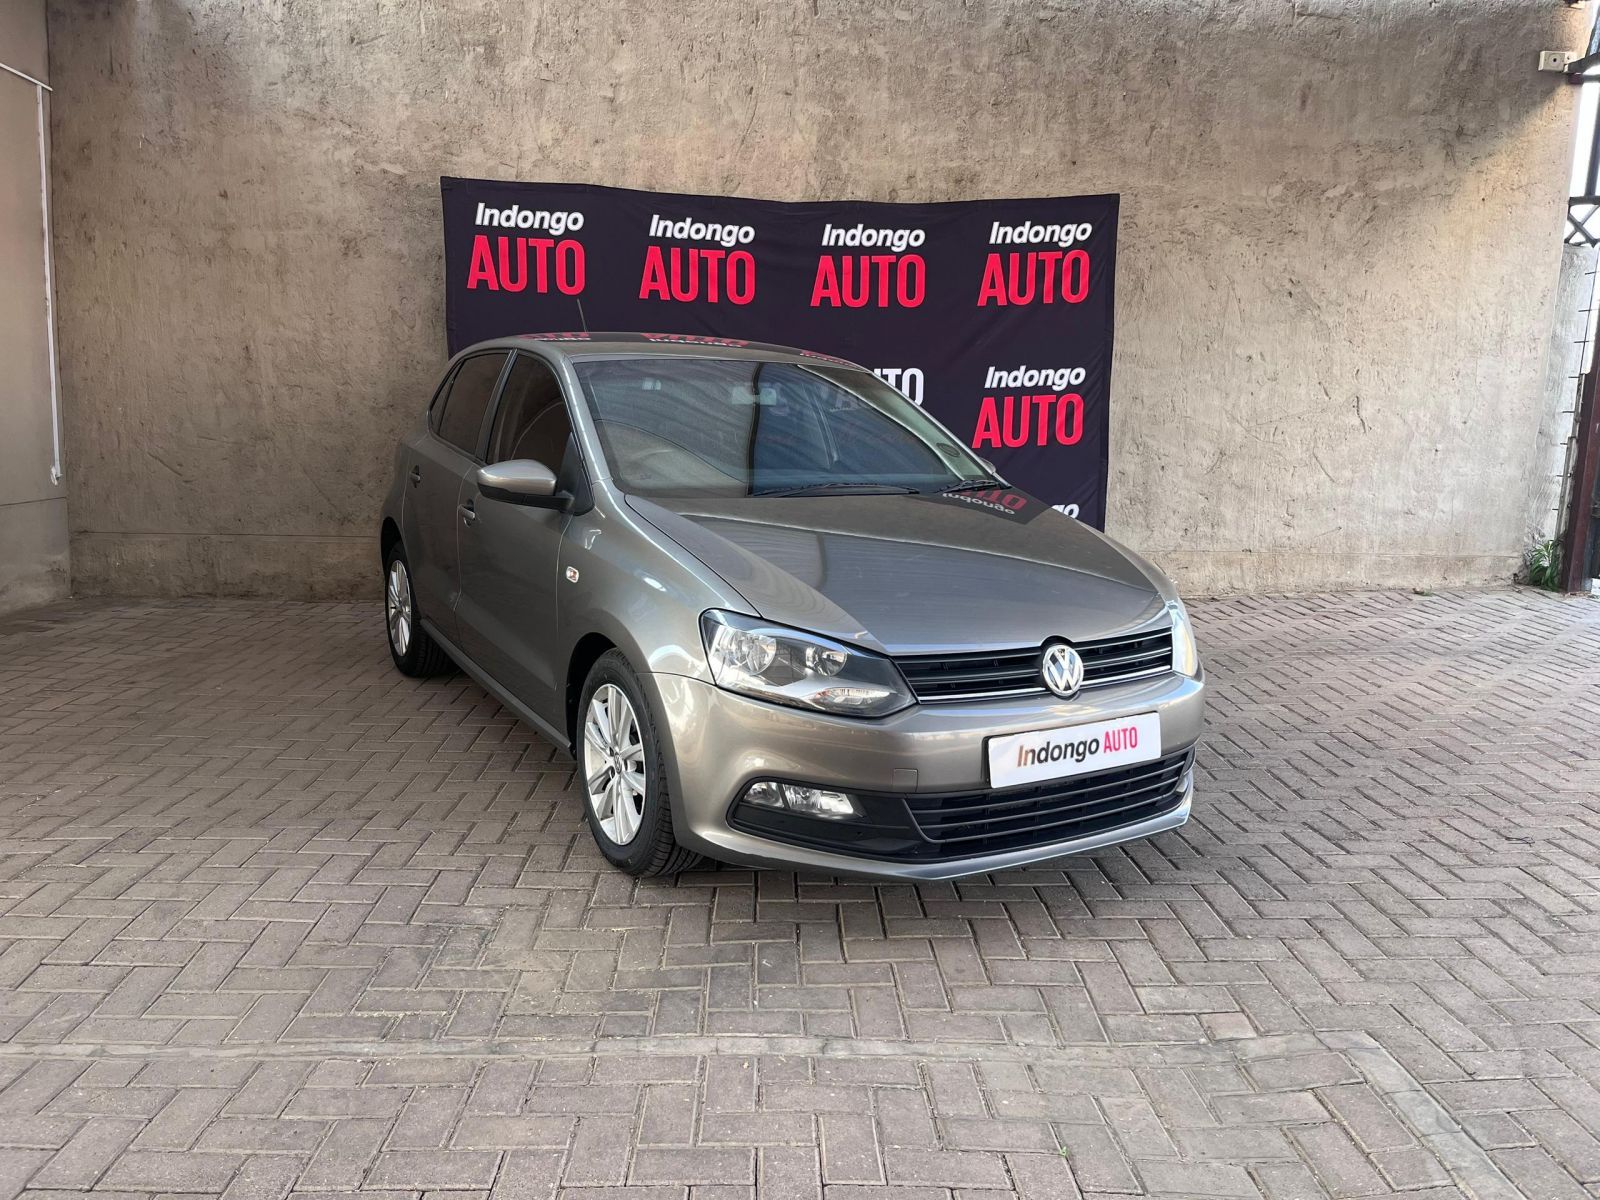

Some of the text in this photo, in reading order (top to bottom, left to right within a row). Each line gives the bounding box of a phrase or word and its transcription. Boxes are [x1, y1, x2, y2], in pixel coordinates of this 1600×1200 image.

[475, 203, 584, 236] Indongo
[649, 214, 756, 247] Indongo
[822, 223, 925, 252] Indongo
[989, 220, 1092, 248] Indongo
[467, 234, 586, 296] AUTO
[639, 244, 757, 306] AUTO
[810, 253, 926, 308] AUTO
[977, 248, 1090, 307] AUTO
[985, 364, 1087, 392] Indongo
[973, 393, 1085, 448] AUTO
[1017, 726, 1138, 767] Indongo AUTO
